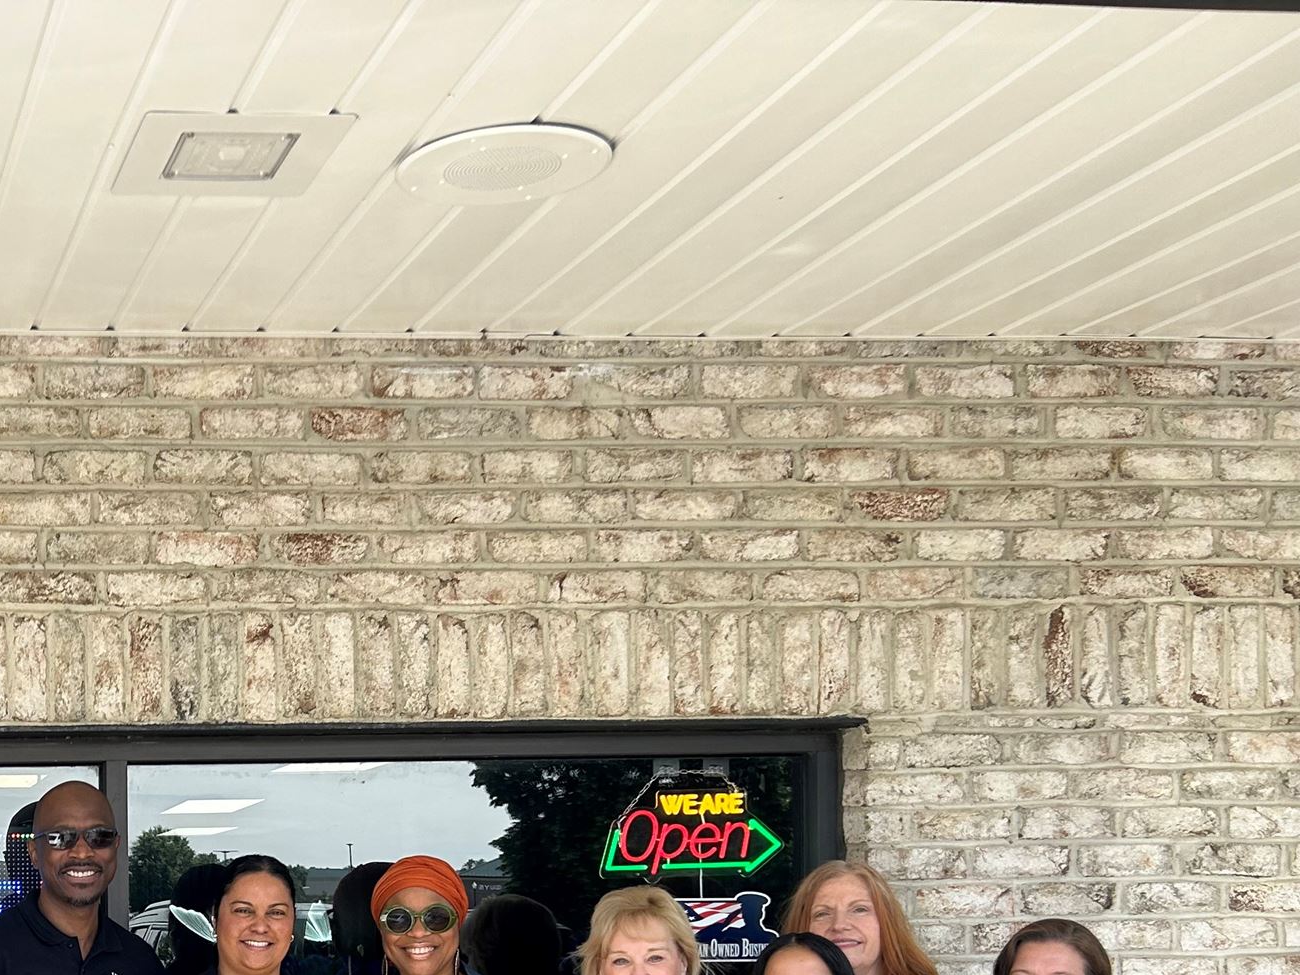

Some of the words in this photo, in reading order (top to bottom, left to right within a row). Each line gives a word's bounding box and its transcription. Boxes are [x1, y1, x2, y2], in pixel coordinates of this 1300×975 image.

[660, 794, 698, 815] WE
[700, 793, 744, 815] ARE
[621, 809, 751, 875] Open
